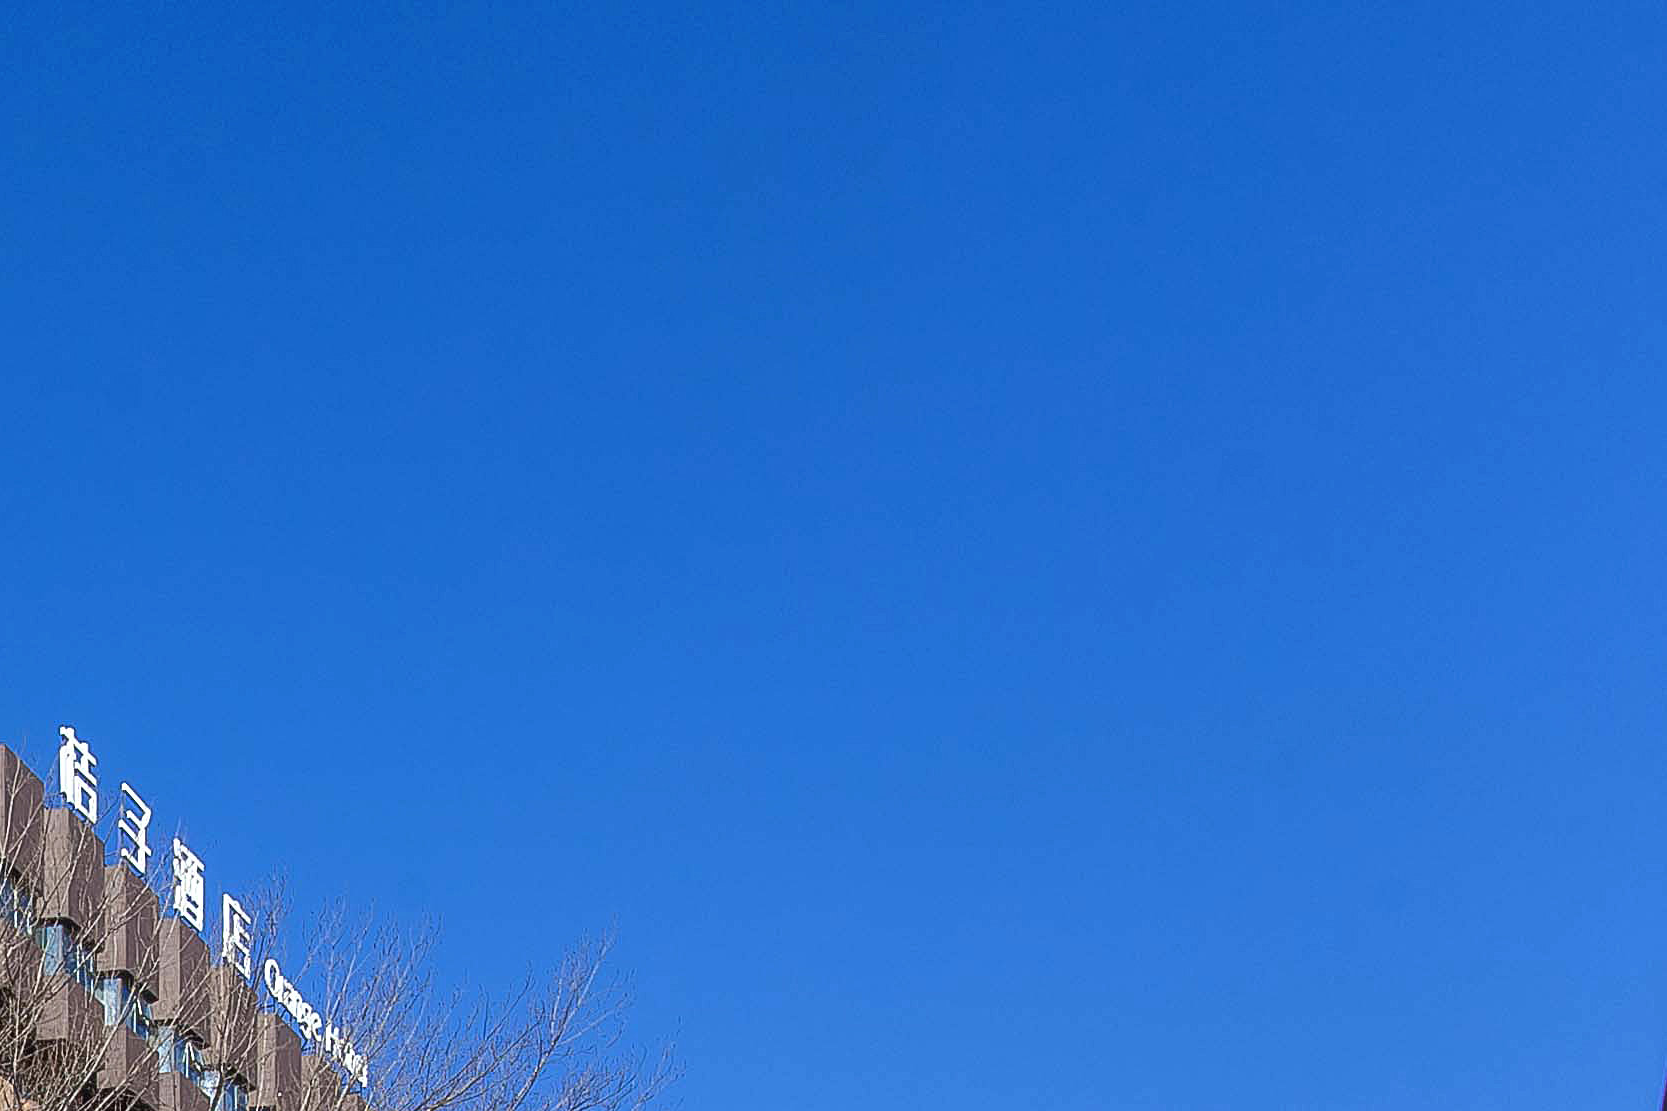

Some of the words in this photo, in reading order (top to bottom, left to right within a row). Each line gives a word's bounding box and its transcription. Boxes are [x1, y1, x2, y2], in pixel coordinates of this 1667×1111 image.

[59, 726, 251, 981] 桔子酒店
[264, 958, 322, 1041] Orange
